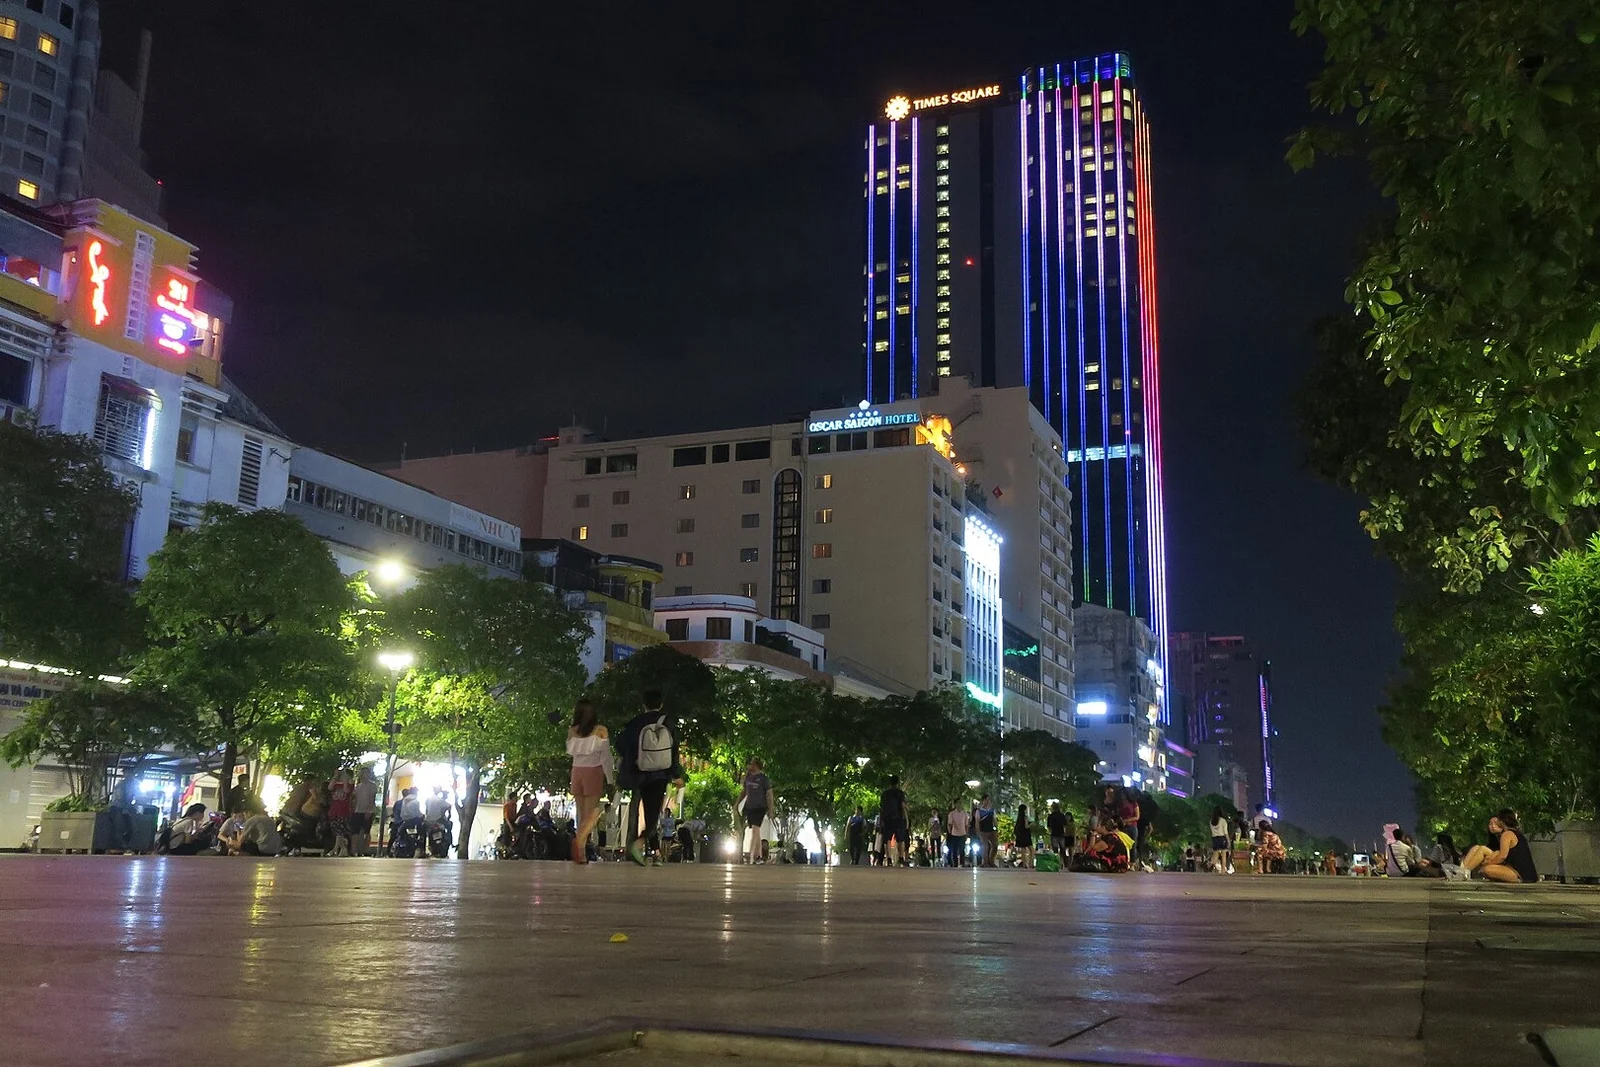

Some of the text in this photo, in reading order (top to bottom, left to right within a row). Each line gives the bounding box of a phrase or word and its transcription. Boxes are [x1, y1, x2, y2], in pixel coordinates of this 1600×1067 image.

[913, 85, 1000, 110] TIMES SQUARE
[809, 413, 920, 432] OSCAR SAIGON HOTEL
